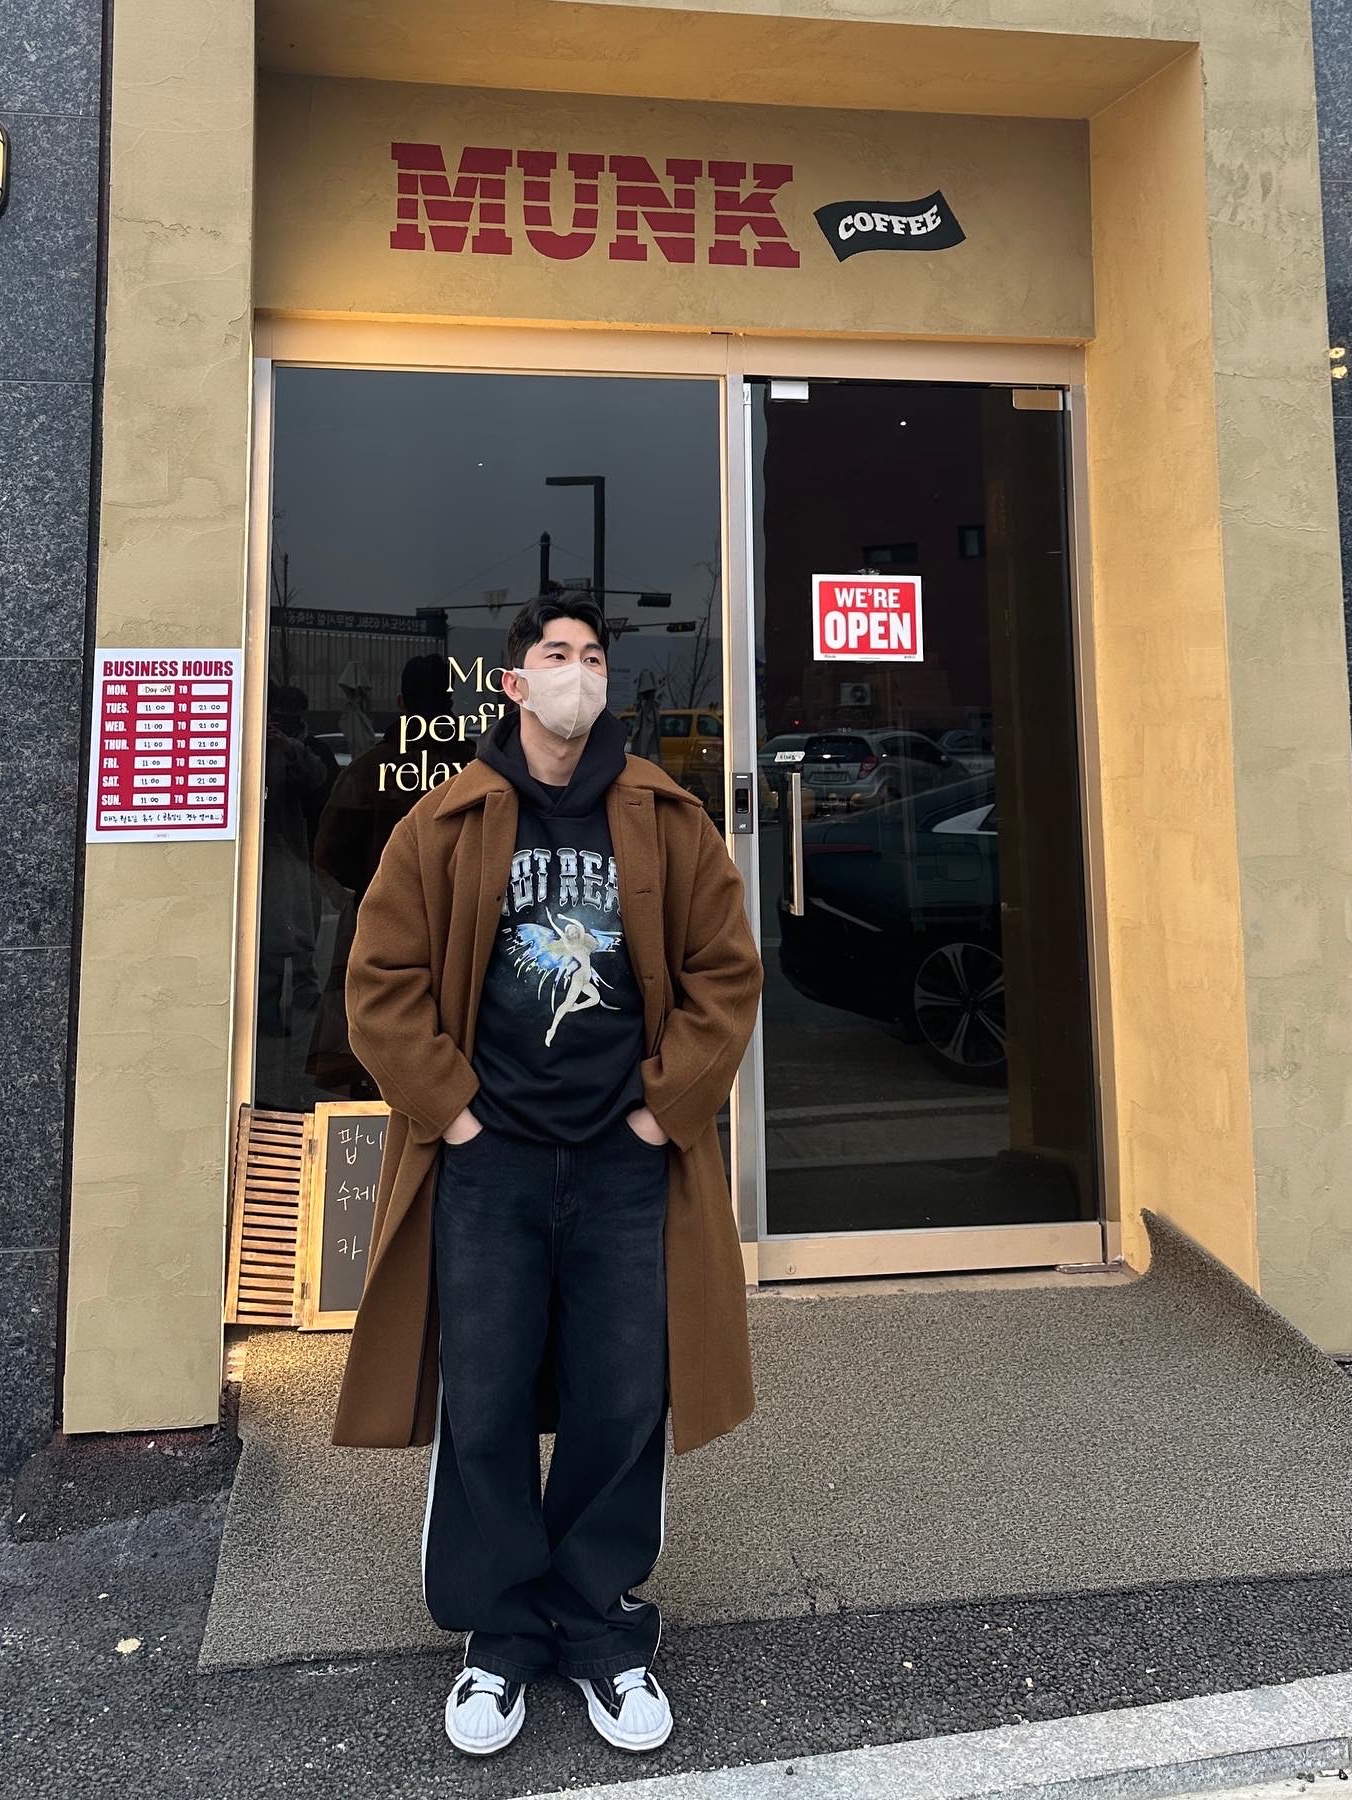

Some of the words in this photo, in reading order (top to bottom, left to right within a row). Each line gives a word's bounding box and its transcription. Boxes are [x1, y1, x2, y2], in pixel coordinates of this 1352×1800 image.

[390, 142, 800, 268] MUNK
[838, 204, 942, 241] COFFEE
[834, 587, 900, 609] WE'RE
[824, 610, 912, 650] OPEN
[103, 660, 178, 677] BUSINESS
[182, 660, 234, 677] HOURS
[107, 684, 128, 696] MON.
[179, 684, 188, 694] TO
[106, 702, 130, 714] TUES.
[178, 703, 188, 712] TO
[105, 721, 127, 732] WED.
[177, 721, 187, 731] TO
[104, 739, 129, 750] THUR.
[176, 740, 186, 749] TO
[103, 757, 119, 769] FRI.
[175, 758, 185, 767] TO
[102, 776, 119, 788] SAT.
[175, 776, 184, 785] TO
[101, 794, 121, 806] SUN.
[174, 794, 184, 804] TO
[337, 1235, 363, 1260] 카
